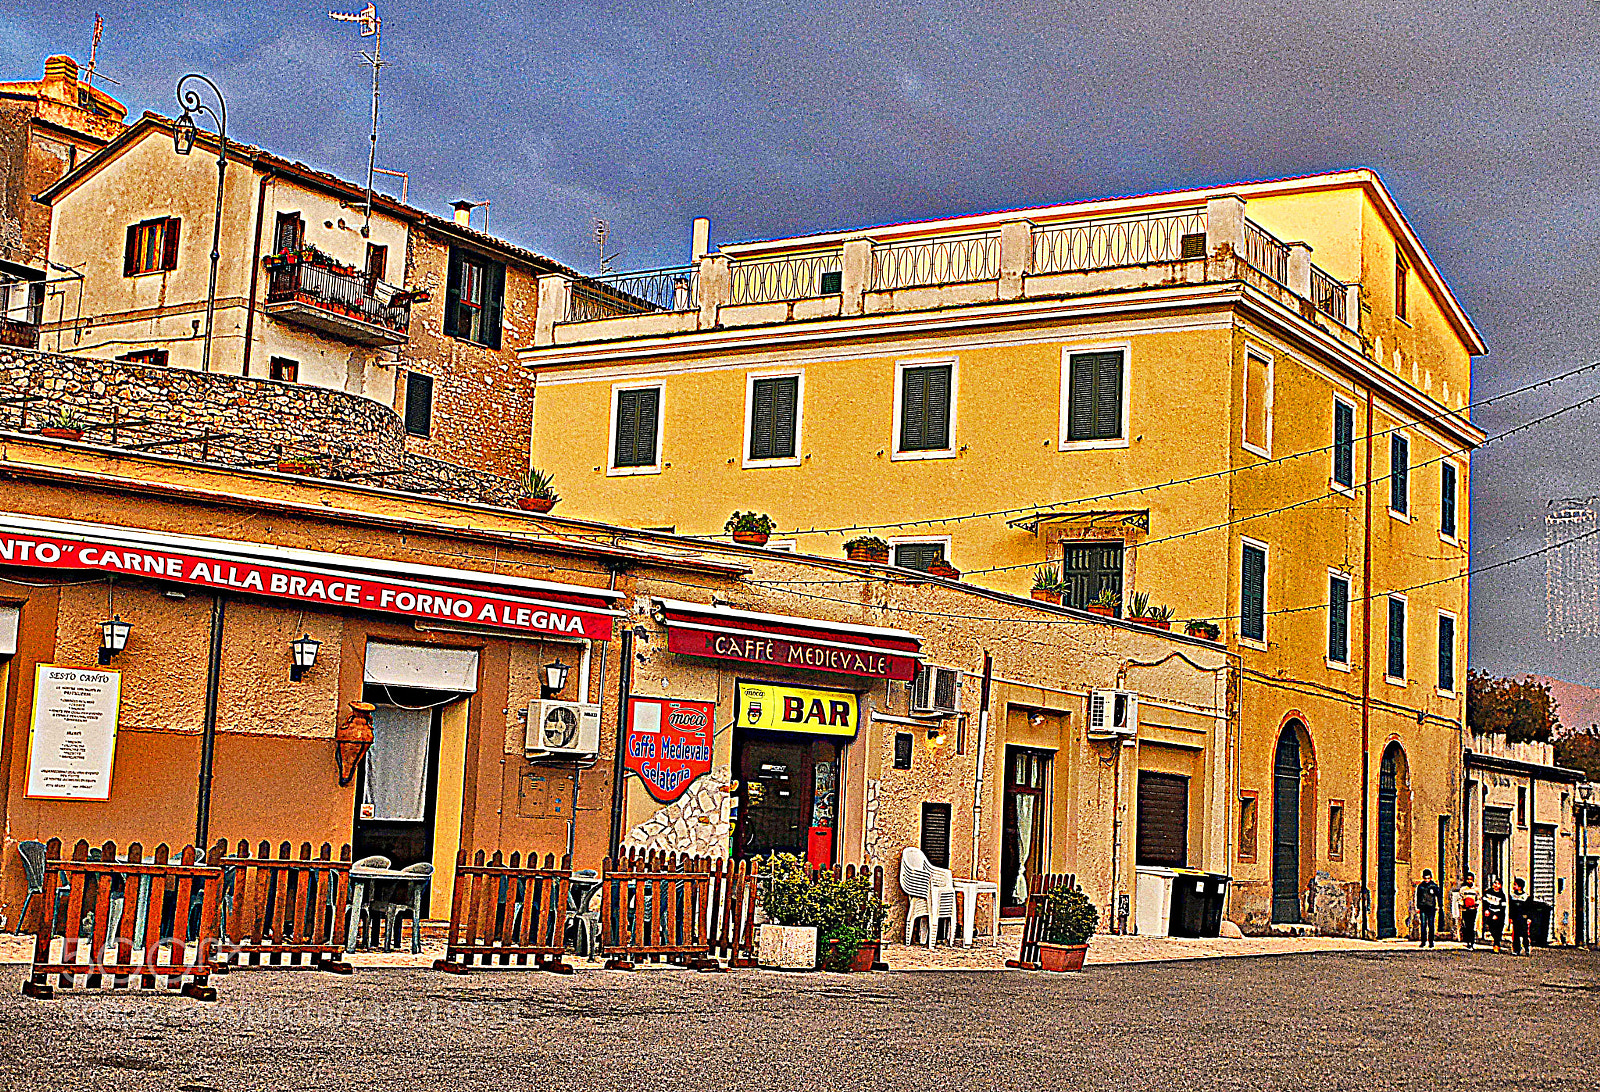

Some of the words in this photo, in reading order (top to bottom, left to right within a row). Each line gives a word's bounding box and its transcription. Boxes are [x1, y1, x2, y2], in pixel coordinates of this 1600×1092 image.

[78, 548, 184, 578] CARNE
[188, 562, 264, 591] ALLA
[270, 573, 362, 603] BRACE
[380, 589, 473, 618] FORNO
[478, 603, 498, 623] A
[502, 606, 585, 635] LEGNA
[715, 636, 774, 661] CAFFÈ
[787, 645, 885, 675] MEDIEVALE
[49, 671, 77, 681] SESTO
[79, 673, 109, 684] CANTO
[669, 712, 706, 727] moca
[782, 696, 850, 728] BAR
[629, 733, 655, 758] Caffè
[661, 735, 709, 761] Medievale
[641, 761, 690, 791] Gelateria
